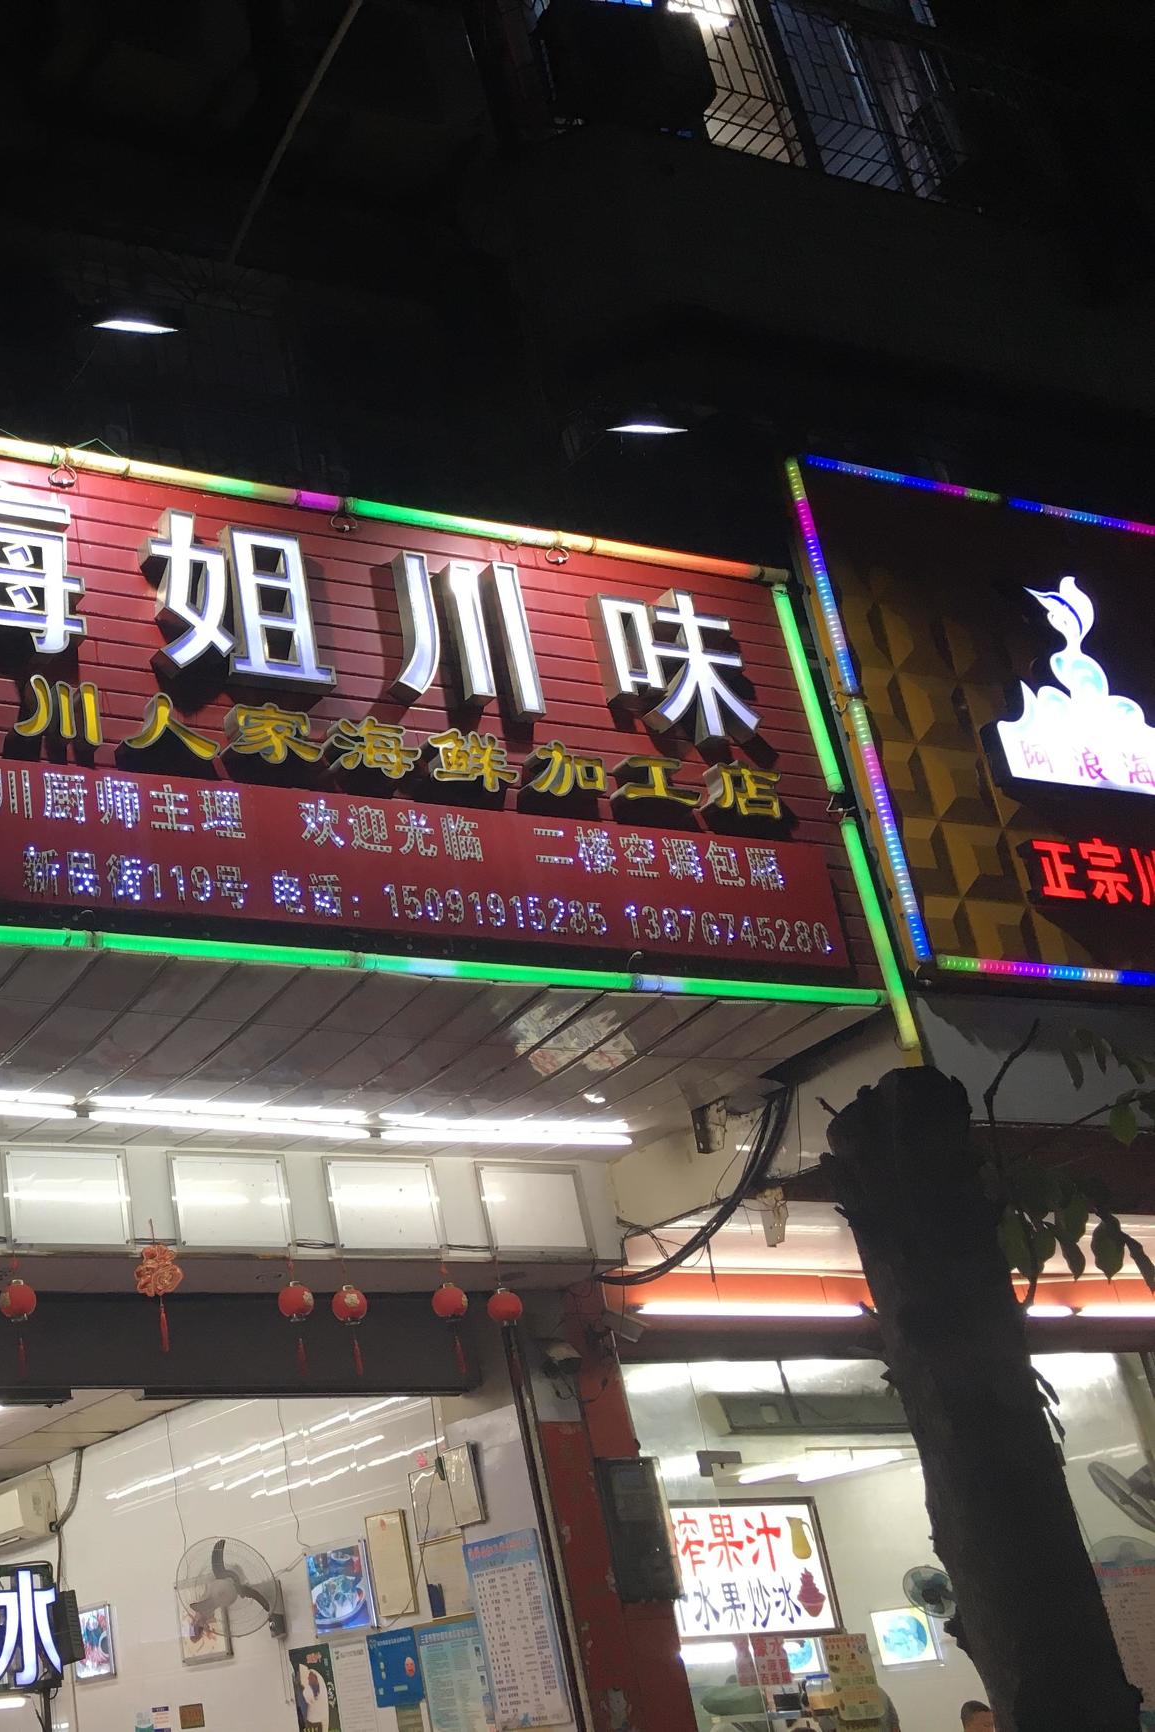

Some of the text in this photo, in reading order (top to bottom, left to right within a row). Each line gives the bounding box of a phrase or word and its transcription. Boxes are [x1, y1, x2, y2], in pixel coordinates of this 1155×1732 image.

[298, 799, 485, 862] 欢迎光临
[533, 825, 786, 891] 二楼空调包厢
[22, 846, 248, 910] 新民街119号
[383, 883, 609, 936] 15091915285
[625, 904, 835, 955] 13876745280
[676, 1575, 802, 1632] 水果炒冰
